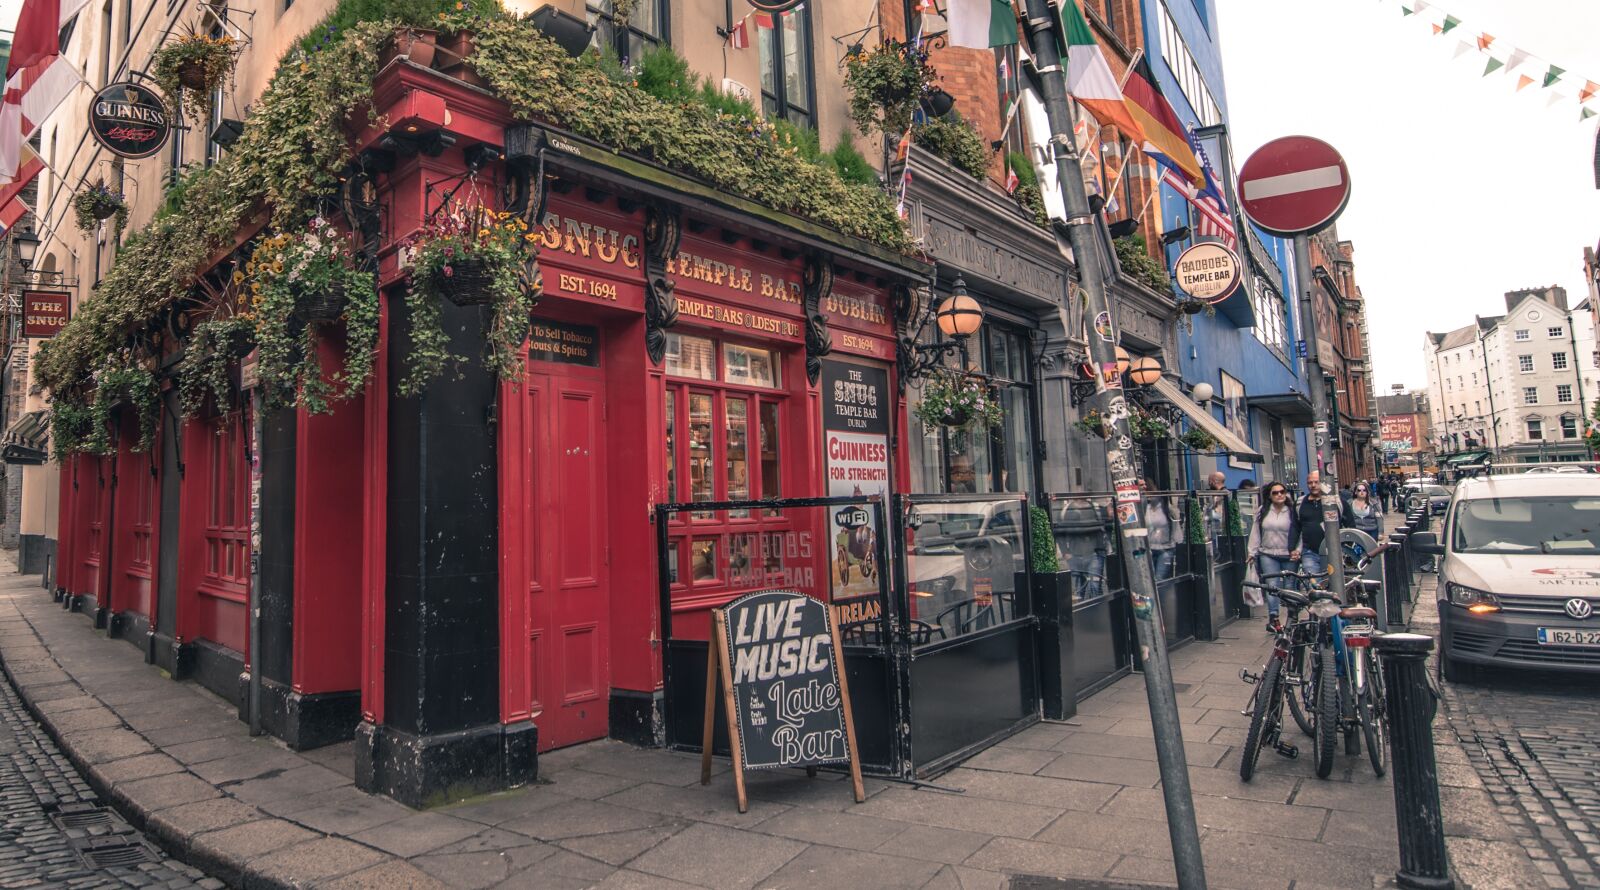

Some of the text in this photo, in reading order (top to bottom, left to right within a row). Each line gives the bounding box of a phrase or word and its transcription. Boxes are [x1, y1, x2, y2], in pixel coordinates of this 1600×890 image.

[96, 102, 164, 124] GUINNESS
[552, 139, 581, 155] GUINNESS
[540, 212, 640, 268] SNUG
[1181, 256, 1229, 273] BADBOBS
[560, 274, 617, 300] EST. 1694
[1184, 270, 1230, 285] TEMPLE BAR
[761, 273, 802, 305] BAR
[32, 302, 62, 312] THE
[675, 297, 715, 319] EMPLE
[715, 306, 743, 325] BARS
[744, 314, 781, 333] OLDEST
[826, 293, 886, 325] DUBLIN
[534, 326, 545, 337] To
[545, 328, 560, 340] Sell
[561, 330, 593, 345] Tobacco
[843, 335, 858, 348] EST.
[552, 343, 560, 353] &
[561, 344, 588, 357] Spirits
[848, 370, 862, 381] THE
[834, 380, 877, 406] SNUG
[835, 404, 877, 419] TEMPLE BAR
[847, 418, 867, 428] DUBLIN
[829, 437, 886, 462] GUINNESS
[830, 467, 886, 481] FOR STRENGTH
[721, 531, 812, 558] BADBOBS
[723, 567, 815, 588] TEMPLE BAR
[735, 597, 807, 646] LIVE
[734, 633, 831, 685] MUSIC
[768, 679, 840, 728] Late
[772, 724, 842, 765] Bar
